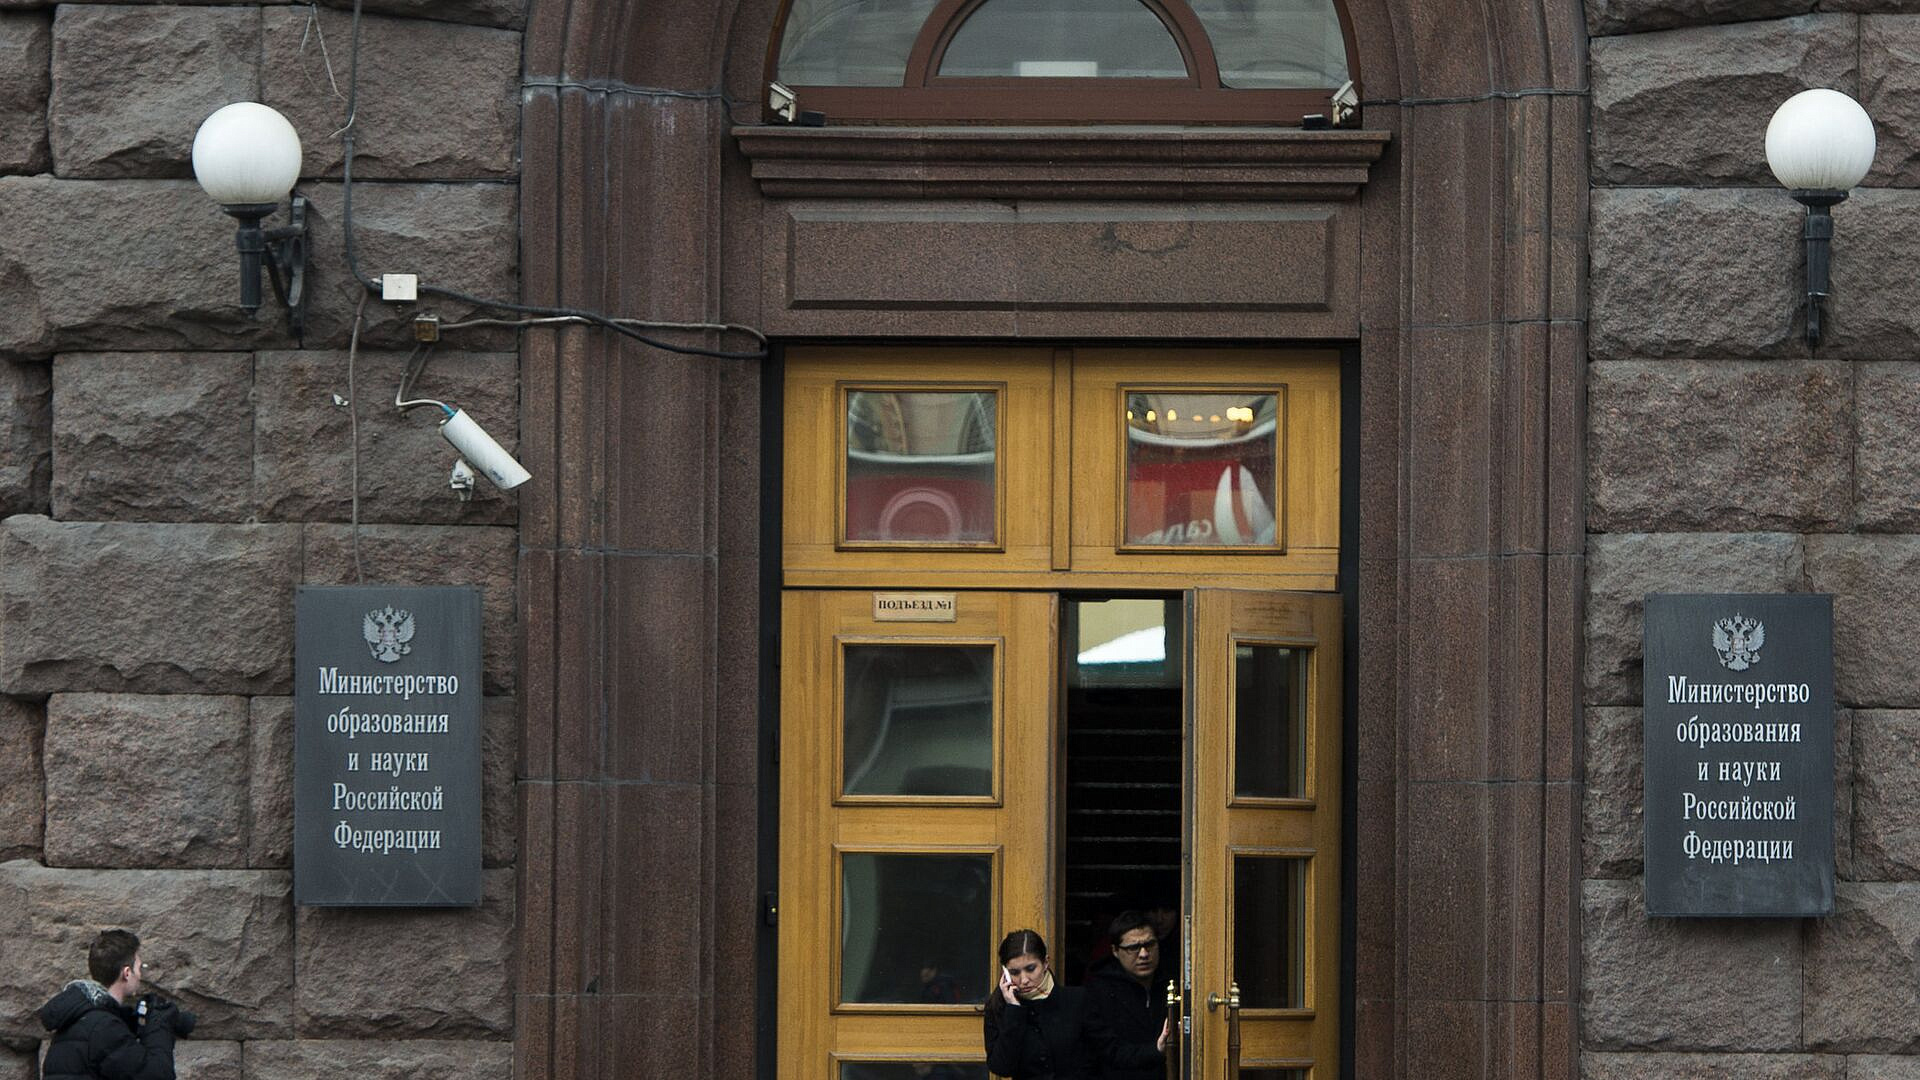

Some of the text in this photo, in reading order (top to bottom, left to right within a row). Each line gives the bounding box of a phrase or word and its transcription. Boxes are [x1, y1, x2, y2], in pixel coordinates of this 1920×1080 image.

[879, 600, 952, 610] ПОДЪЕЗД №1
[318, 667, 458, 700] Министерство
[1668, 675, 1810, 709] Министерство
[327, 706, 449, 739] образования
[1677, 715, 1801, 749] образования
[348, 753, 428, 777] и науки
[1698, 762, 1781, 787] и науки
[333, 783, 443, 811] Российской
[1683, 793, 1796, 821] Российской
[334, 820, 440, 855] Федерации
[1683, 830, 1793, 865] Федерации
